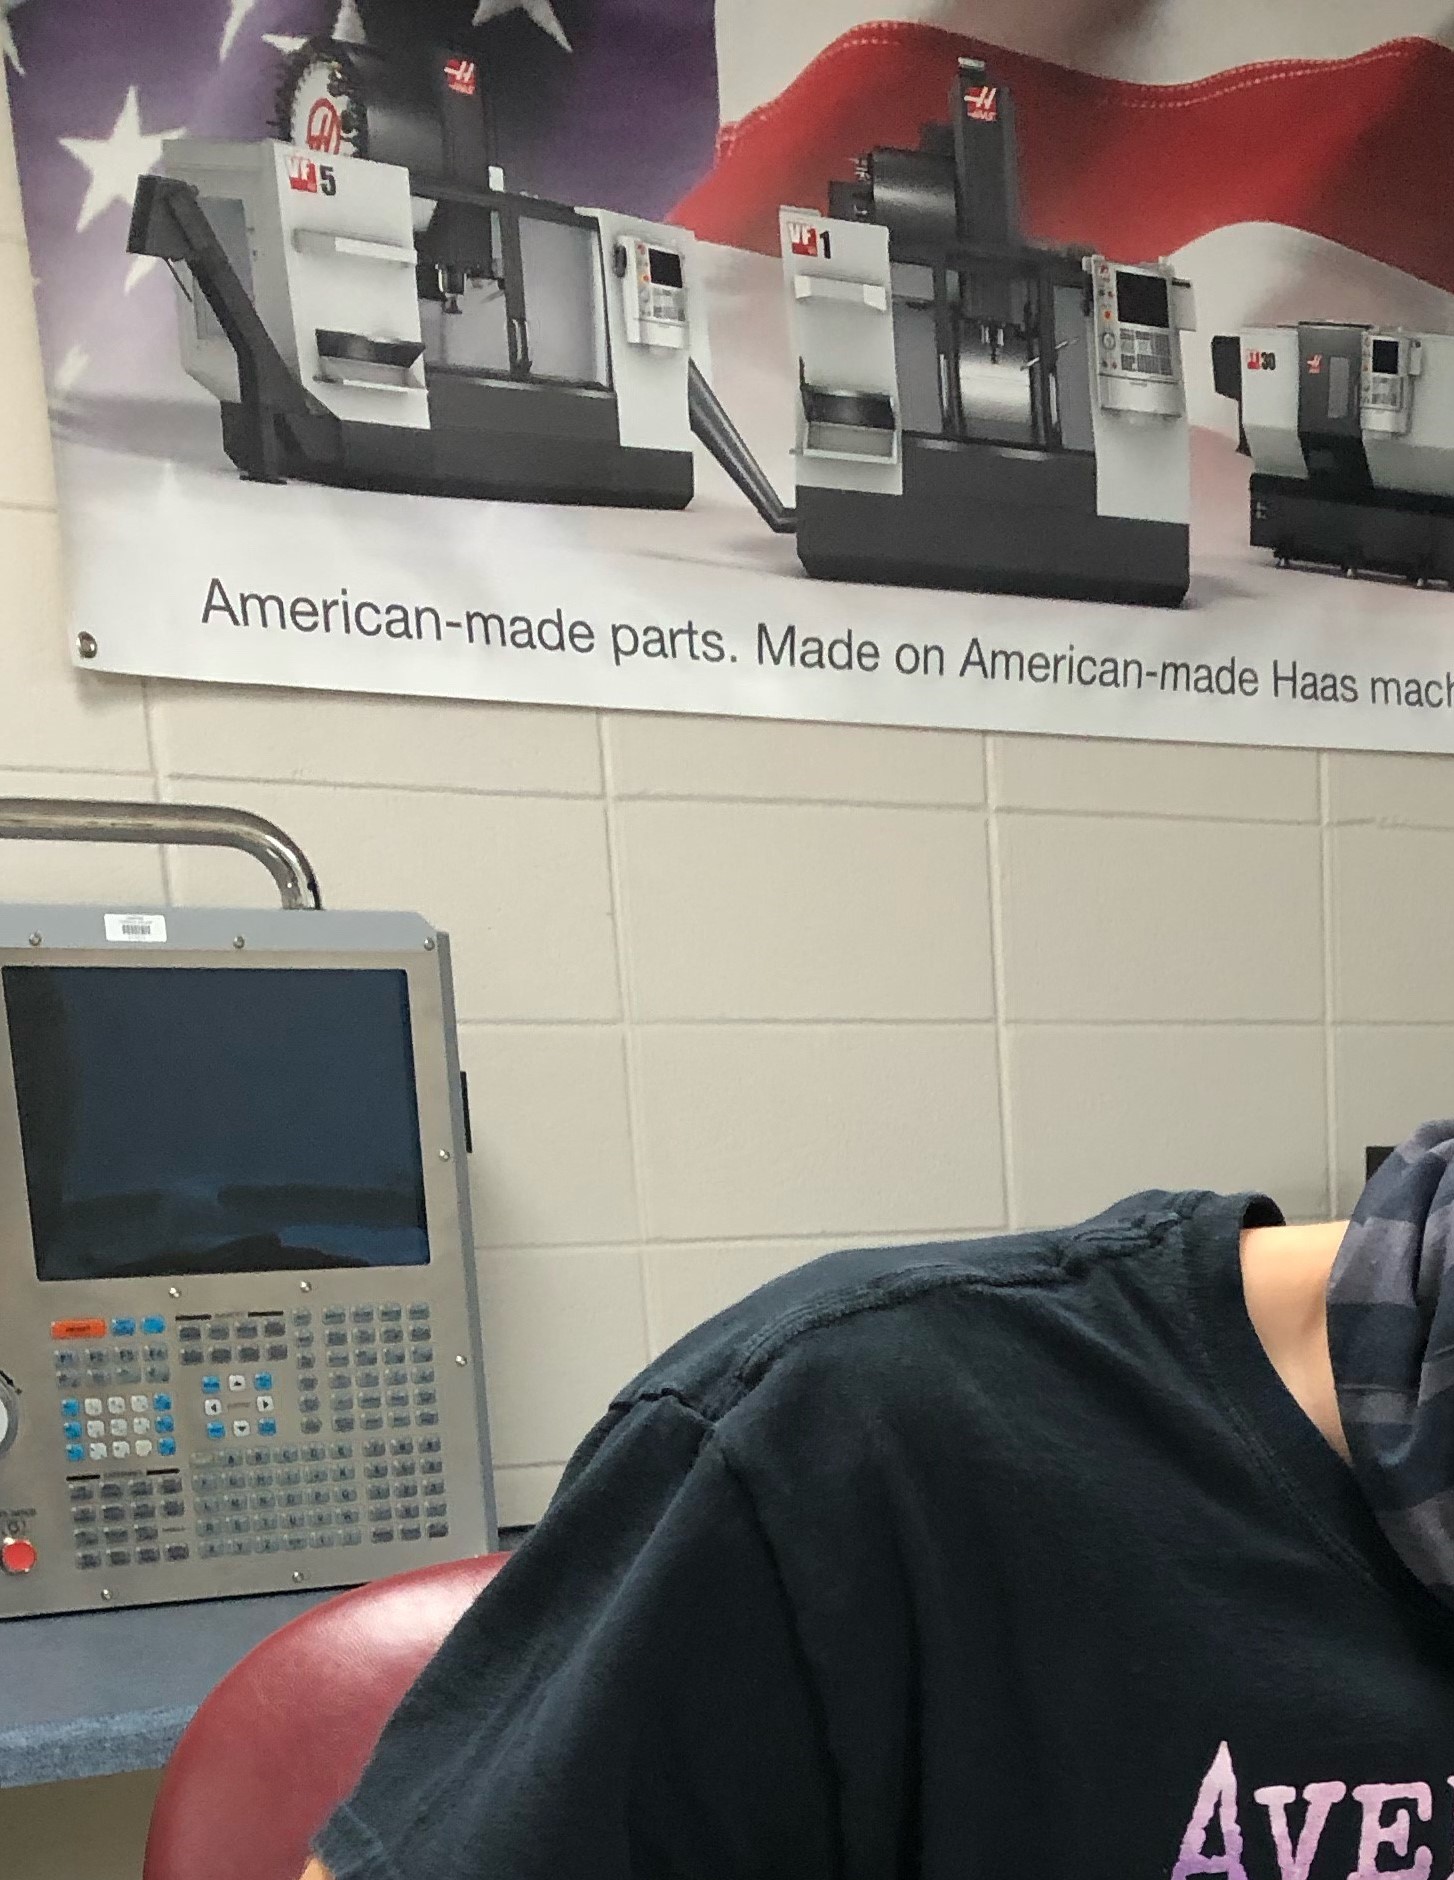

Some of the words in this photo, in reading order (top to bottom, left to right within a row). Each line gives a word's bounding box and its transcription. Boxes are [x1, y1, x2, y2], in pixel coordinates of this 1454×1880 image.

[320, 165, 337, 196] 5
[819, 230, 831, 259] 1
[201, 577, 595, 653] American-made
[611, 620, 737, 666] parts.
[758, 623, 880, 672] Made
[896, 641, 944, 677] on
[959, 638, 1259, 697] American-made
[1273, 660, 1358, 703] Haas
